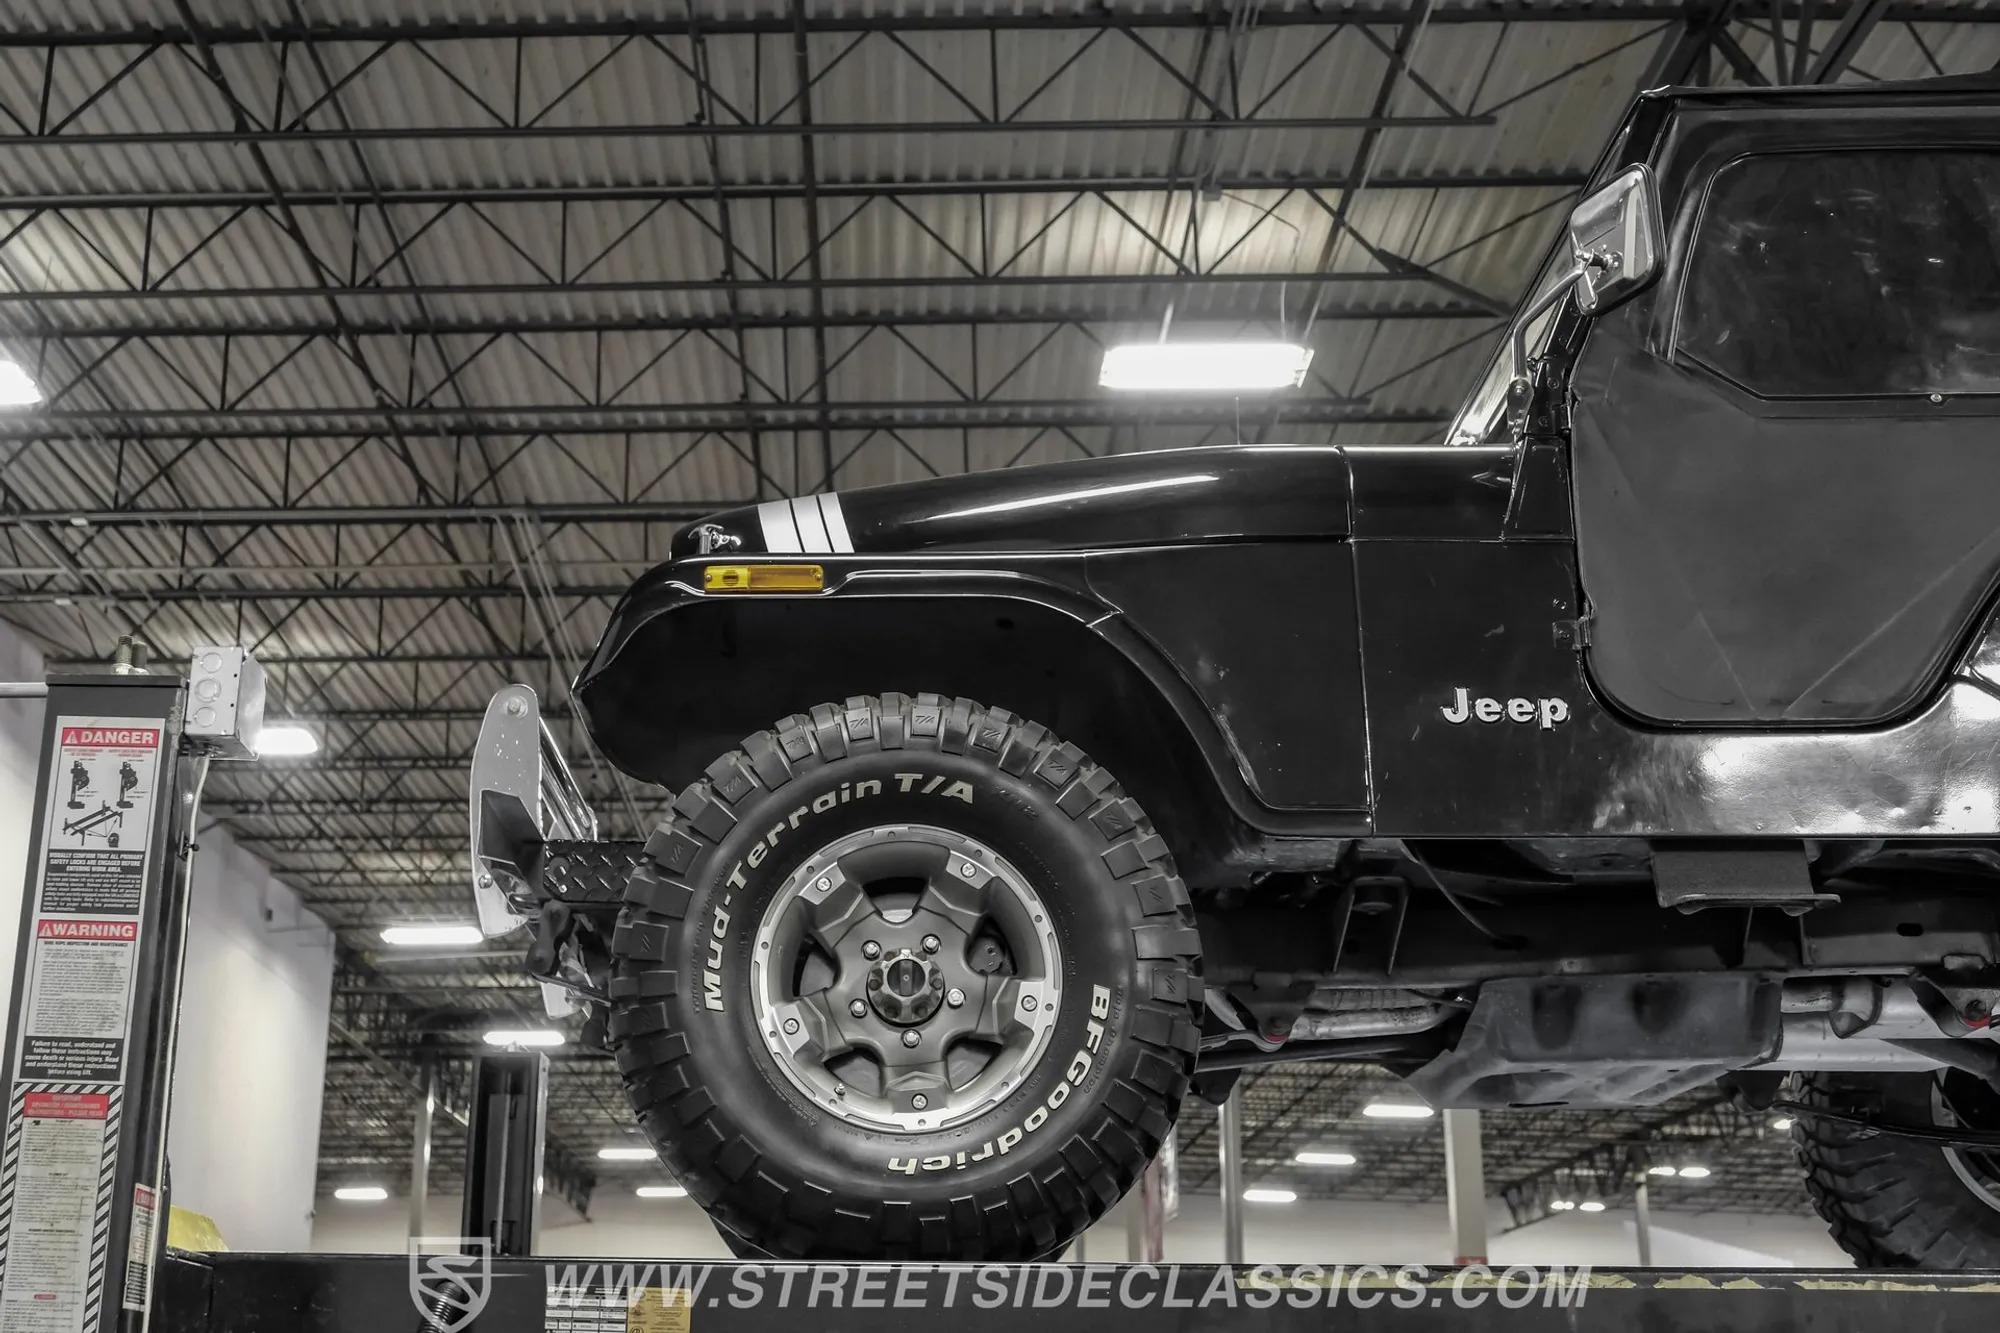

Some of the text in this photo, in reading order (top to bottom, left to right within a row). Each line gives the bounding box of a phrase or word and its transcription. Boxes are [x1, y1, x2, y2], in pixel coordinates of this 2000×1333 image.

[1441, 687, 1570, 731] Jeep
[80, 731, 154, 744] DANGER
[703, 779, 883, 1012] Mud-Terrain
[894, 773, 975, 804] T/A
[52, 923, 134, 937] WARNING
[887, 984, 1111, 1175] BFGoodrich
